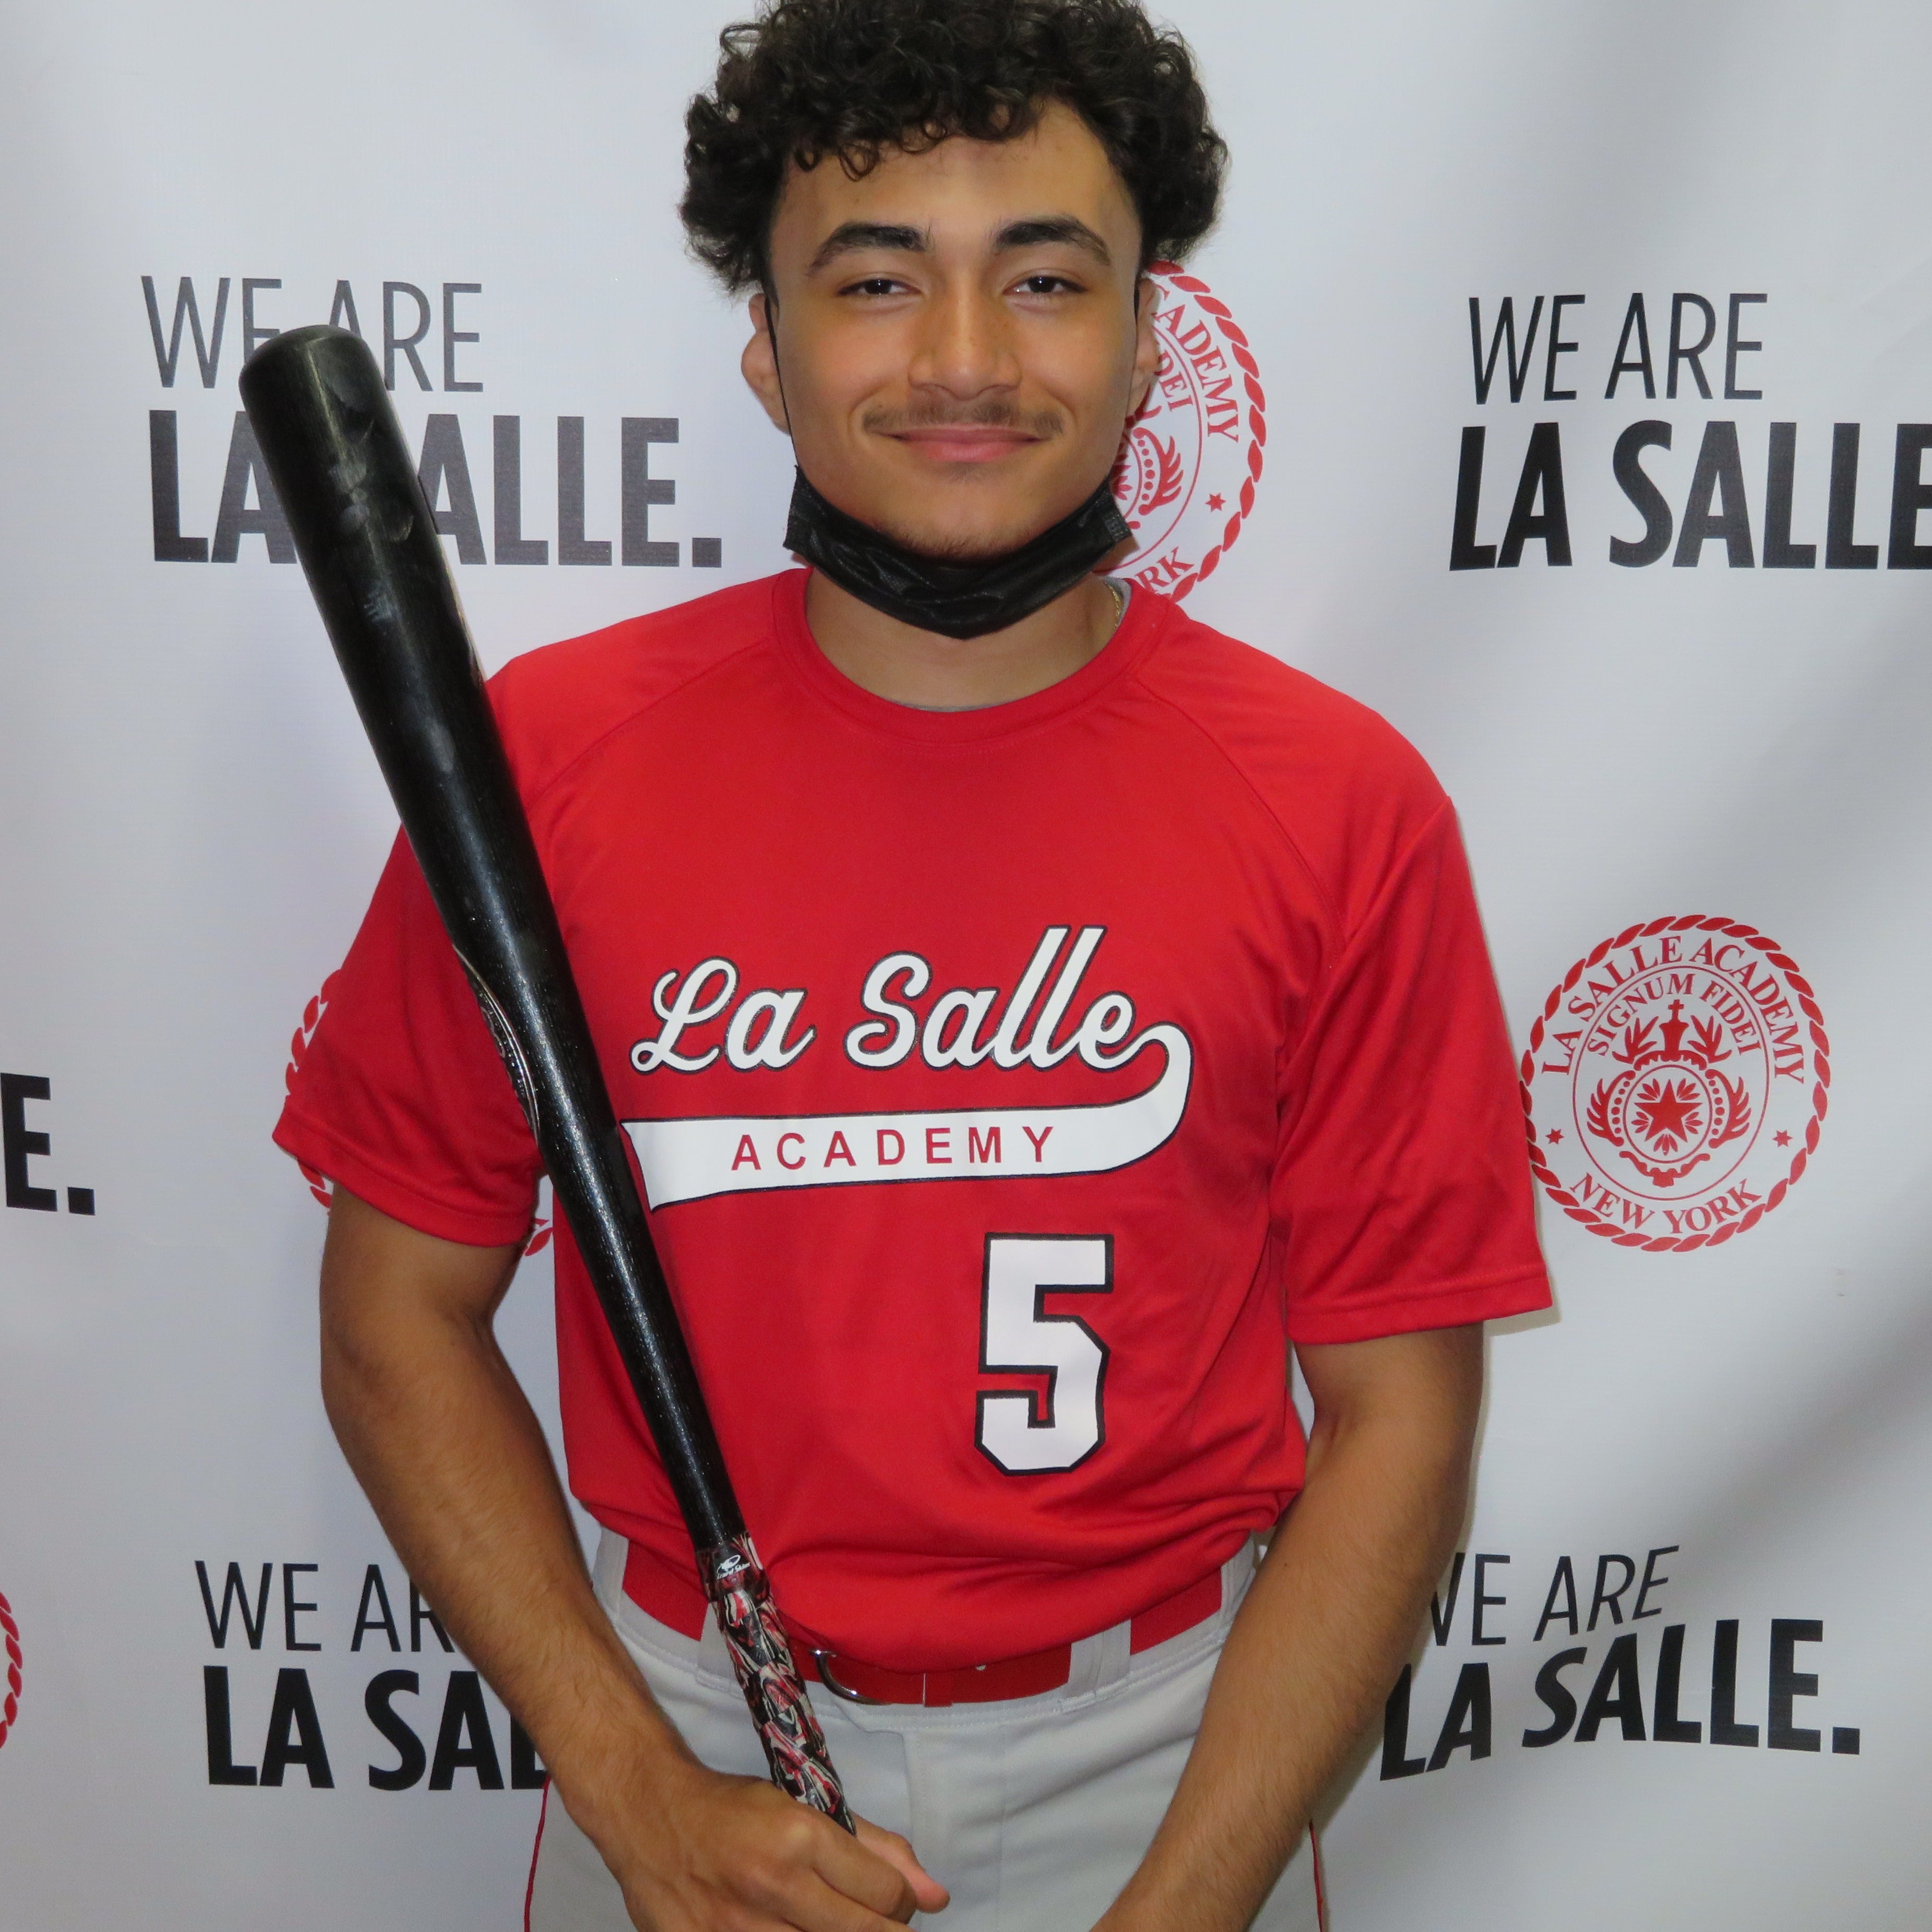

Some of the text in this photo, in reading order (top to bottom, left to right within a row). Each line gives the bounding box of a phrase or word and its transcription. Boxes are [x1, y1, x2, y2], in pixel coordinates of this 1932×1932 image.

[1469, 292, 1768, 405] WE ARE
[149, 410, 722, 567] LA ALLE.
[1449, 420, 1932, 571] LA SALLE
[629, 924, 1146, 1073] La Salle
[1542, 935, 1805, 1084] LA SALLE ACADEMY
[1588, 973, 1762, 1056] SIGNUM FIDEI
[731, 1125, 1054, 1171] ACADEMY
[1569, 1172, 1763, 1234] NEW YORK
[974, 1232, 1114, 1476] 5
[194, 1560, 455, 1653] WE AR
[1533, 1545, 1679, 1642] ARE
[203, 1665, 548, 1791] LA SAL
[1380, 1618, 1860, 1781] LA SALLE.
